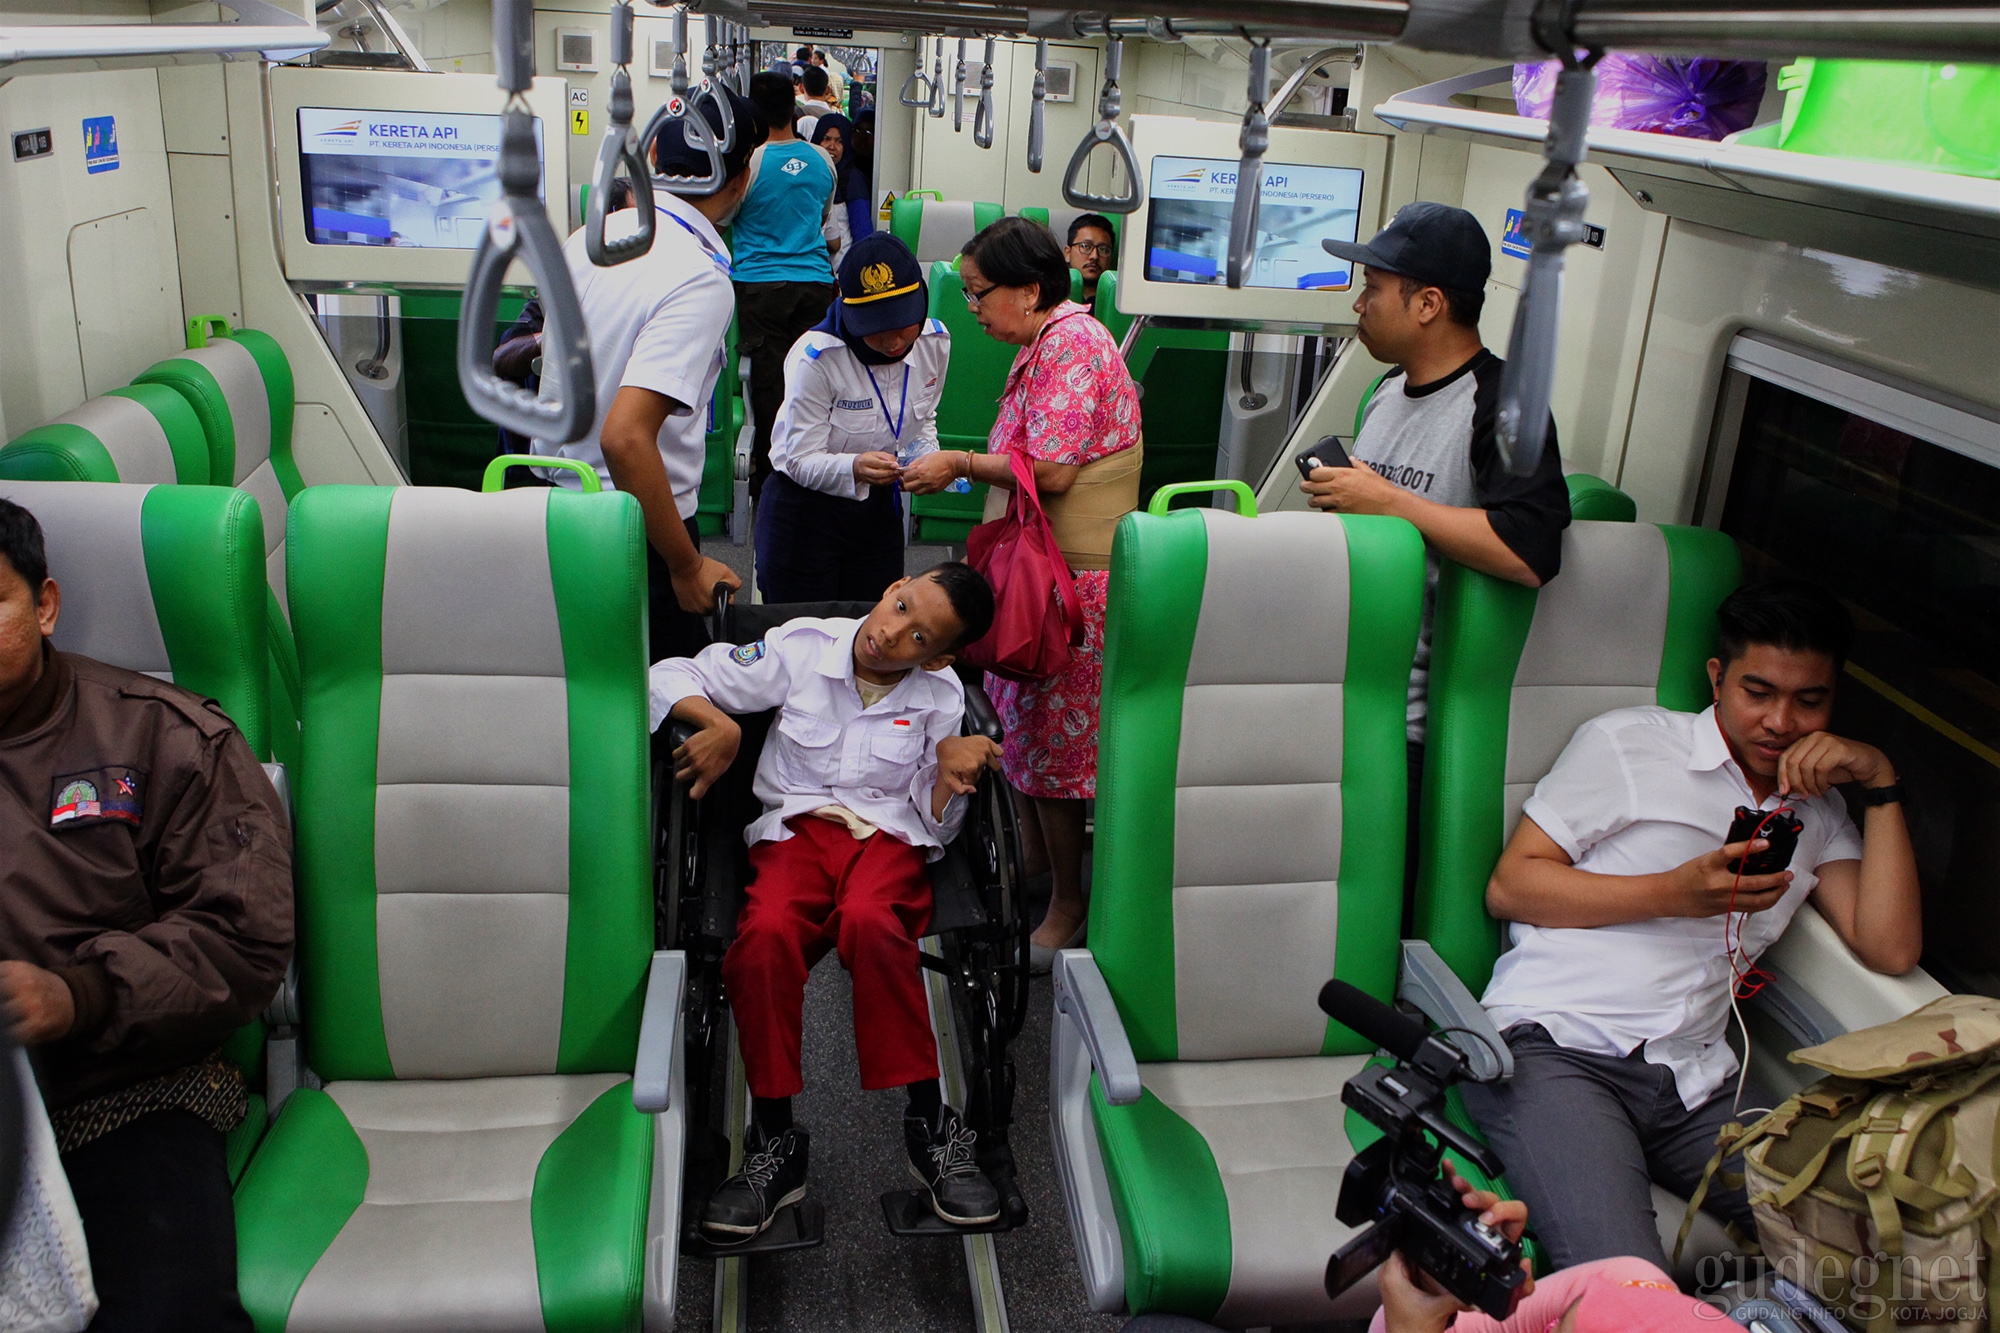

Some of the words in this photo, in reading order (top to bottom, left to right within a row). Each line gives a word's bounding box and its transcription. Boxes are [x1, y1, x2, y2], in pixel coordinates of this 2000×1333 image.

[572, 92, 587, 102] AC
[368, 124, 429, 139] KERETA
[432, 126, 458, 139] API
[369, 140, 381, 148] PT.
[382, 141, 412, 149] KERETA
[428, 143, 473, 151] INDONESIA
[473, 144, 500, 152] (PERSE
[786, 161, 802, 172] 93
[1265, 176, 1288, 188] API
[1260, 190, 1298, 199] INDONESIA
[1299, 191, 1335, 201] (PERSERO)
